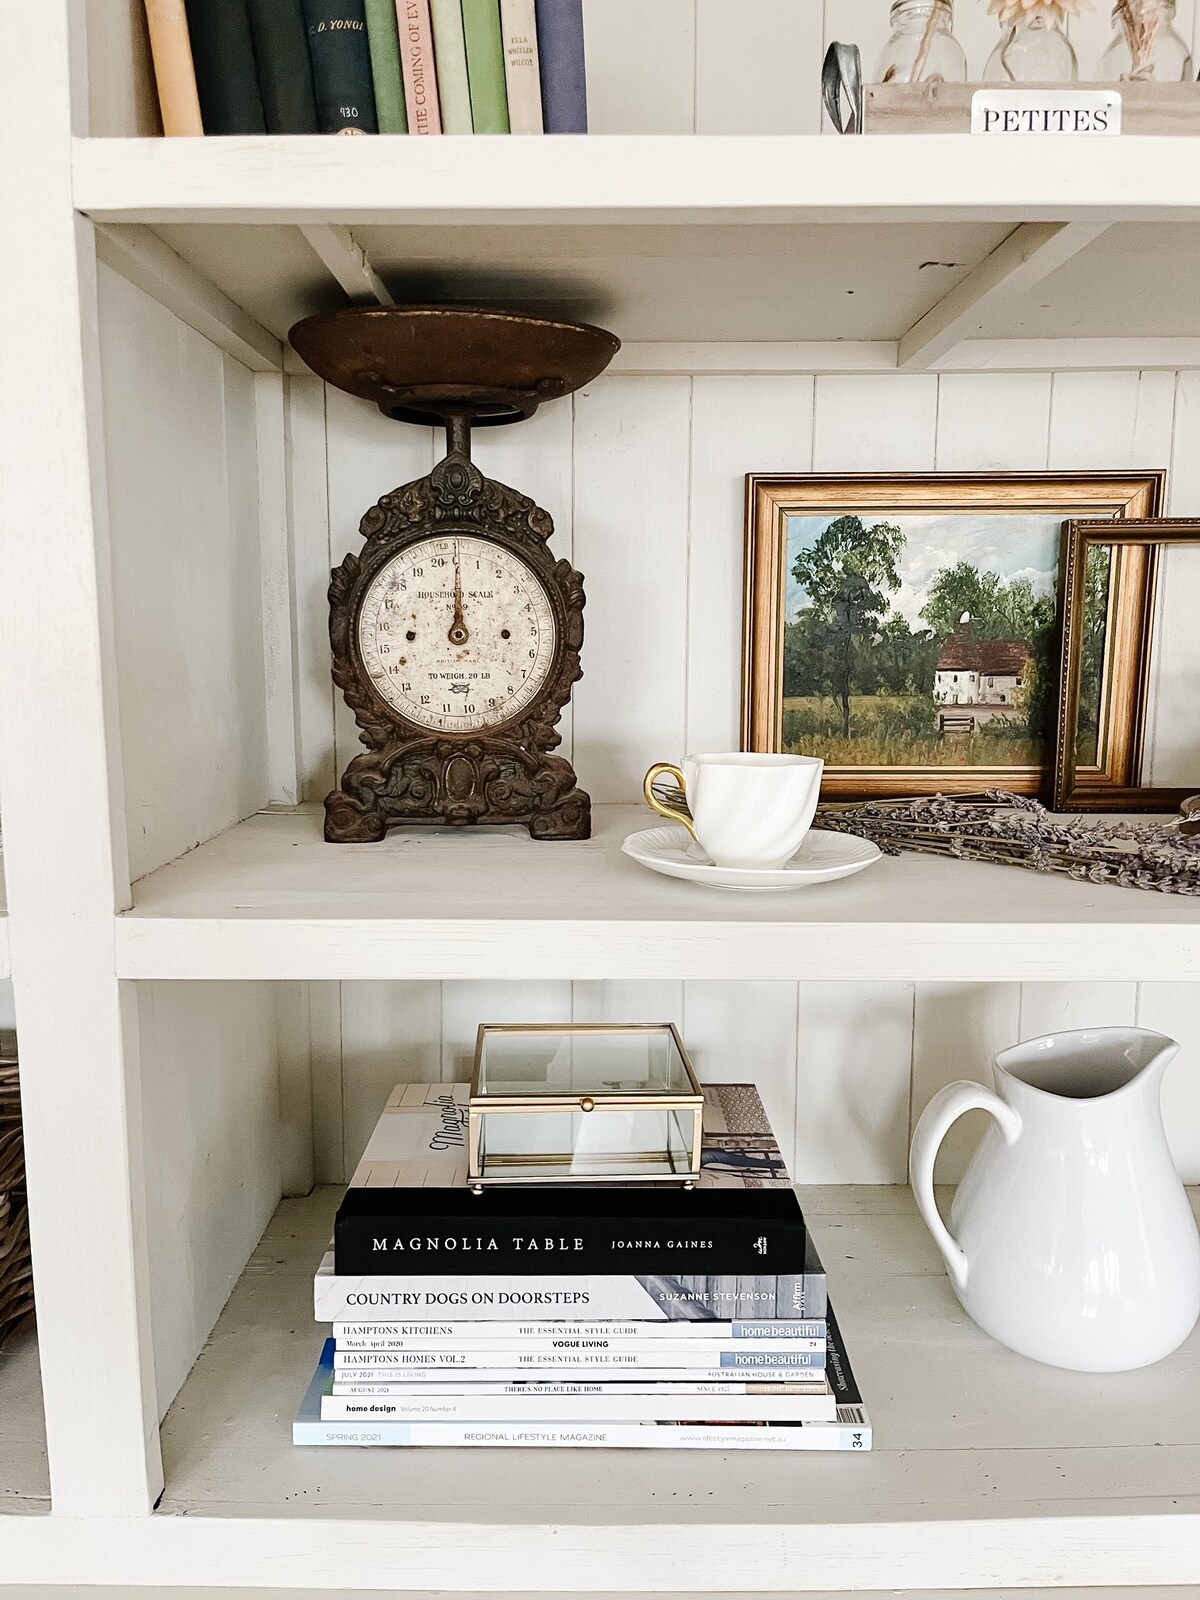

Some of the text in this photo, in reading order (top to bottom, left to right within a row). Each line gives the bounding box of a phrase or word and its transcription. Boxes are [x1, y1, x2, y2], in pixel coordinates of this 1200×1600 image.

[318, 22, 327, 32] D.
[408, 24, 420, 42] OF
[511, 36, 528, 44] ELLA
[410, 46, 426, 106] COMING
[340, 107, 358, 118] 930
[983, 109, 1108, 132] PETITES
[430, 558, 444, 568] 20
[476, 560, 480, 570] 1
[412, 568, 424, 578] 19
[495, 570, 502, 579] 2
[418, 591, 494, 599] HOUSEHOD SCALE
[513, 586, 520, 594] 3
[524, 603, 532, 612] 4
[379, 622, 390, 632] 16
[530, 626, 537, 636] 5
[380, 644, 390, 654] 15
[528, 648, 536, 658] 6
[388, 666, 399, 674] 14
[520, 669, 526, 678] 7
[401, 682, 412, 692] 13
[507, 686, 514, 695] 8
[420, 694, 430, 704] 12
[488, 698, 495, 707] 9
[442, 704, 451, 712] 11
[464, 704, 476, 714] 10
[422, 1095, 465, 1150] Magnolia
[372, 1238, 584, 1250] MAGNOLIA TABLE
[611, 1240, 714, 1249] JOANNA GAINES
[346, 1292, 590, 1305] COUNTRY DOGS ON DOORSTEPS
[660, 1292, 776, 1301] SUZANNE STEVENSON
[792, 1282, 801, 1310] Affirm
[343, 1326, 453, 1334] HAMPTONS KITCHENS
[344, 1355, 466, 1364] HAMPTONS HOMES VOL.2
[370, 1405, 396, 1413] design
[852, 1433, 863, 1448] 34
